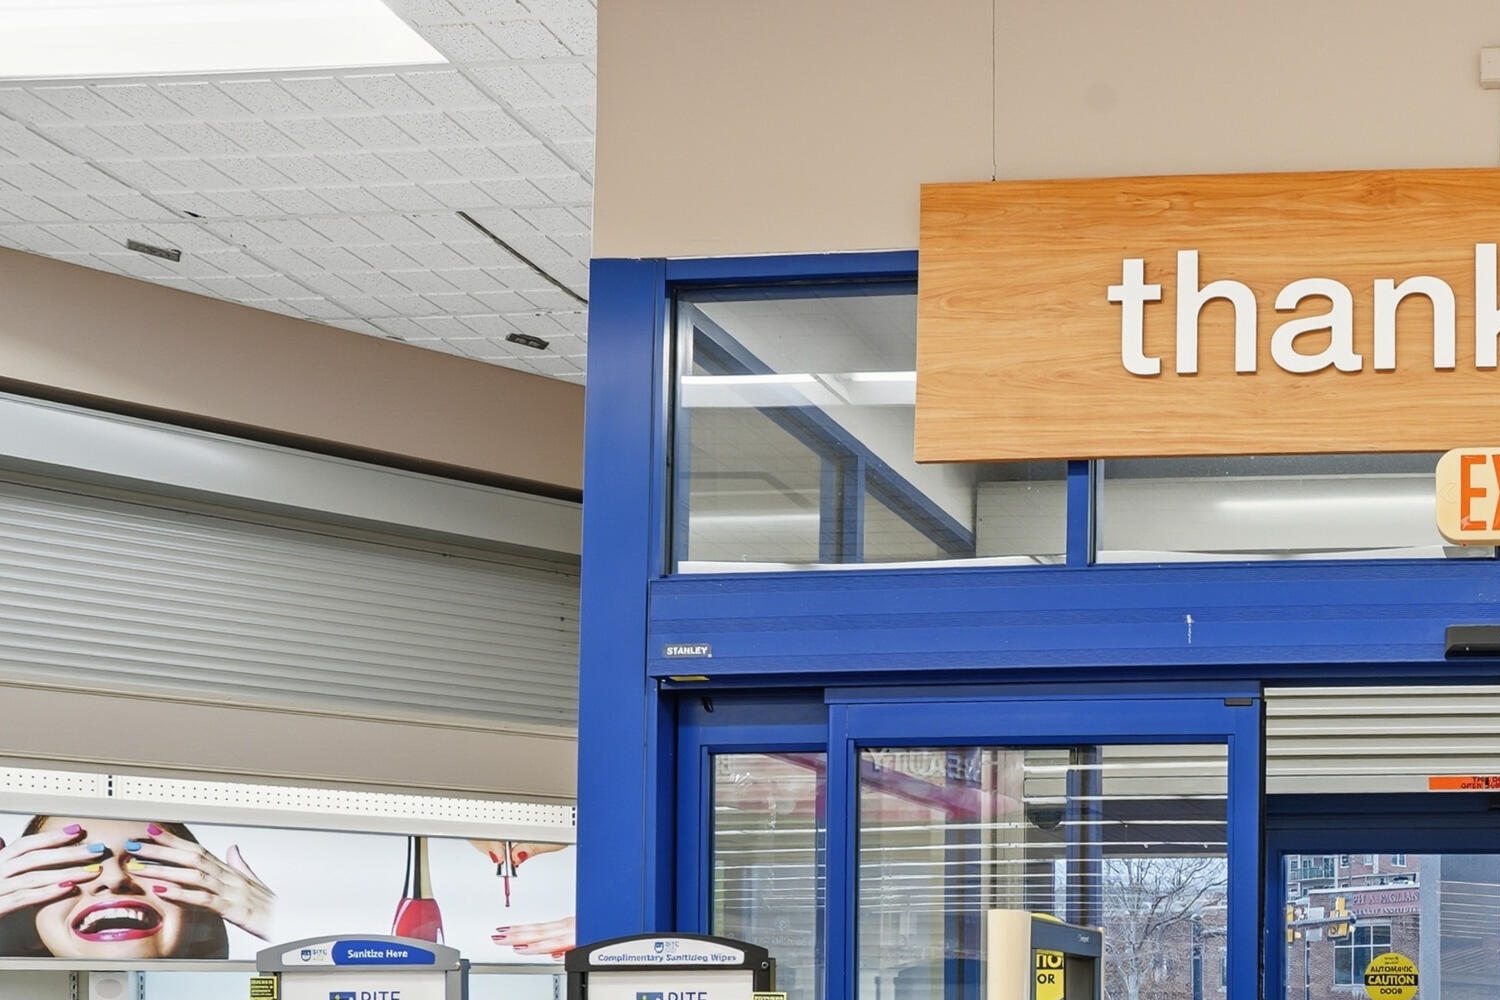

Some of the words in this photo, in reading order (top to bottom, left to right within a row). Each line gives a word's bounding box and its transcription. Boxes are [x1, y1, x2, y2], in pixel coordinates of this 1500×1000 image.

[666, 646, 708, 655] STANLEY
[348, 949, 384, 959] Sanitize
[386, 949, 408, 958] Here
[598, 954, 663, 964] Complimentary
[1037, 974, 1055, 984] OR
[1368, 975, 1415, 985] CAUTION
